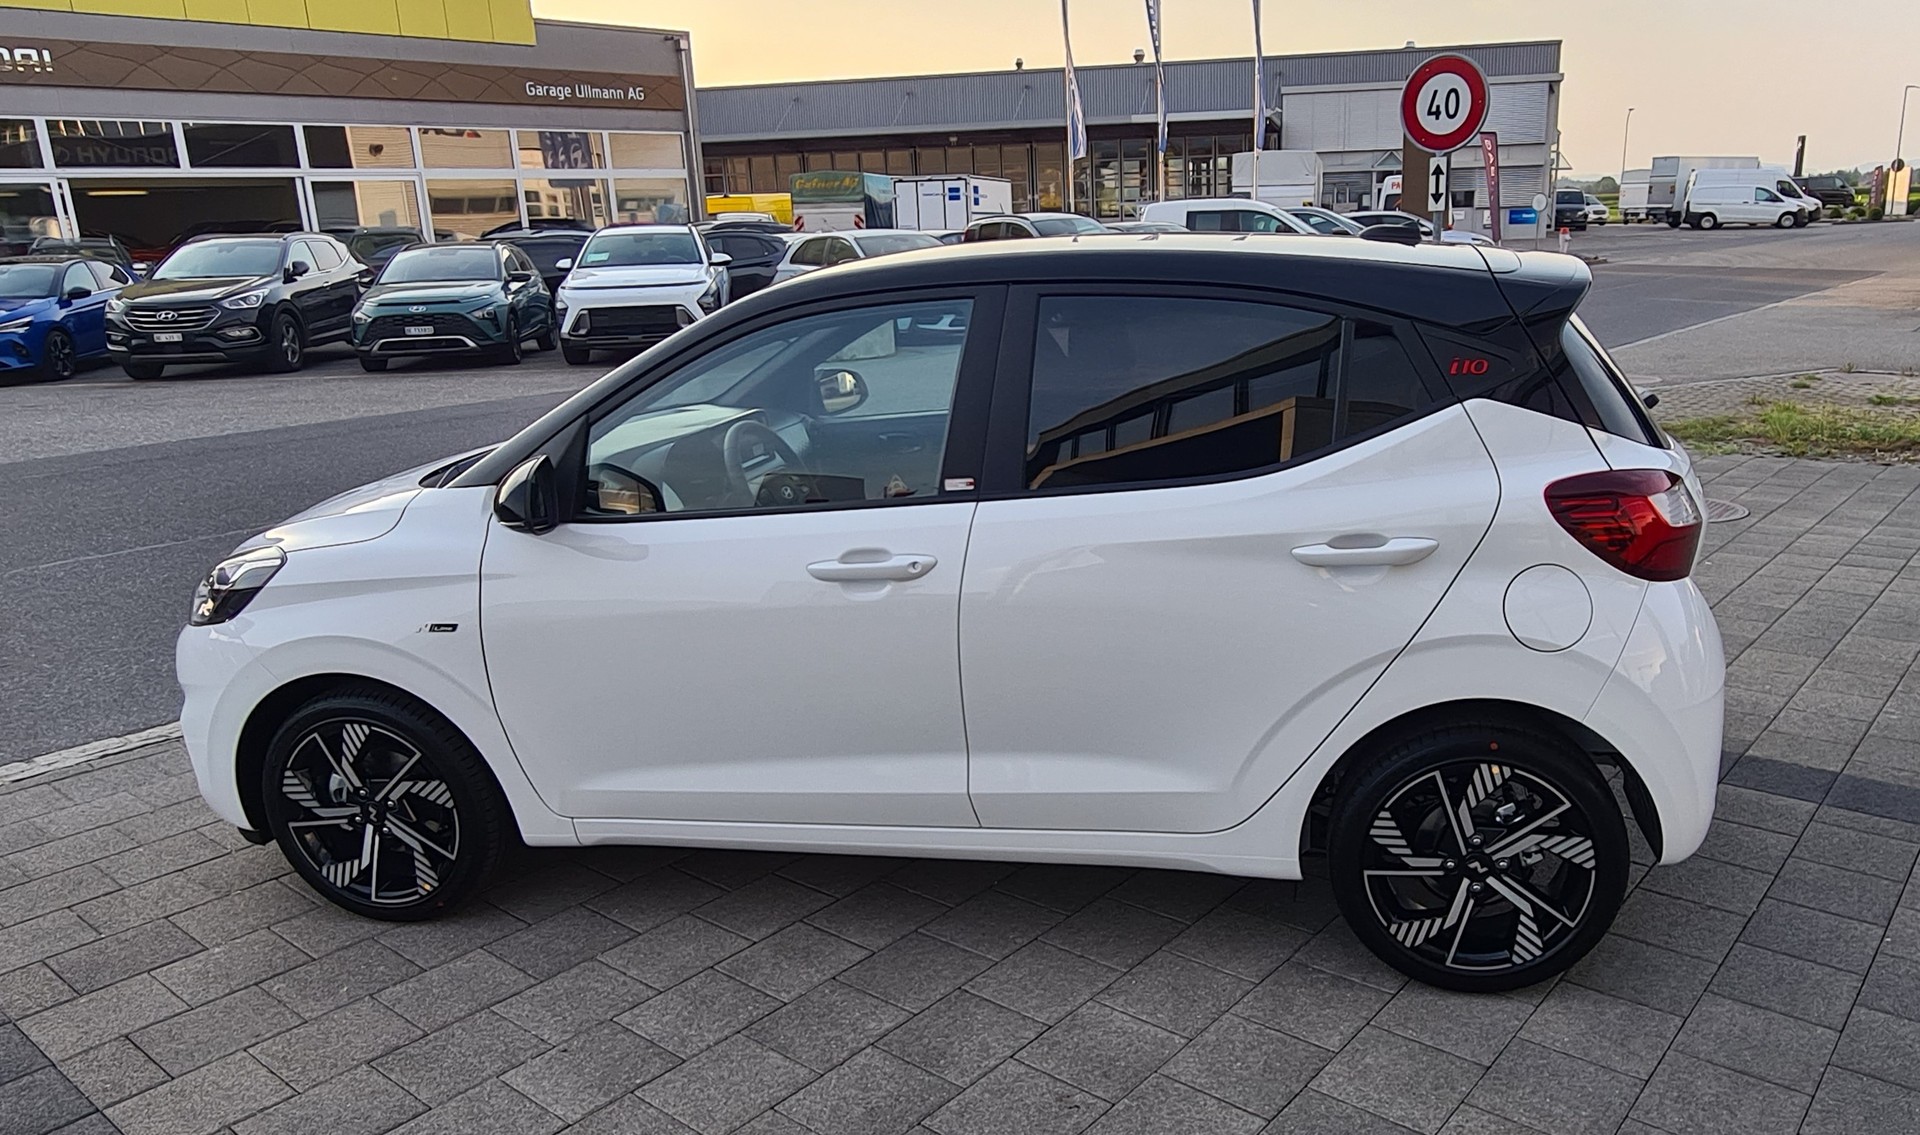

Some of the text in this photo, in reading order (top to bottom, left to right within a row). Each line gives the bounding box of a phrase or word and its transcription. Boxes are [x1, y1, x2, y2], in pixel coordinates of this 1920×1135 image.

[525, 81, 645, 101] Garage Ullmann AG
[1427, 87, 1460, 121] 40
[1450, 357, 1488, 374] i10
